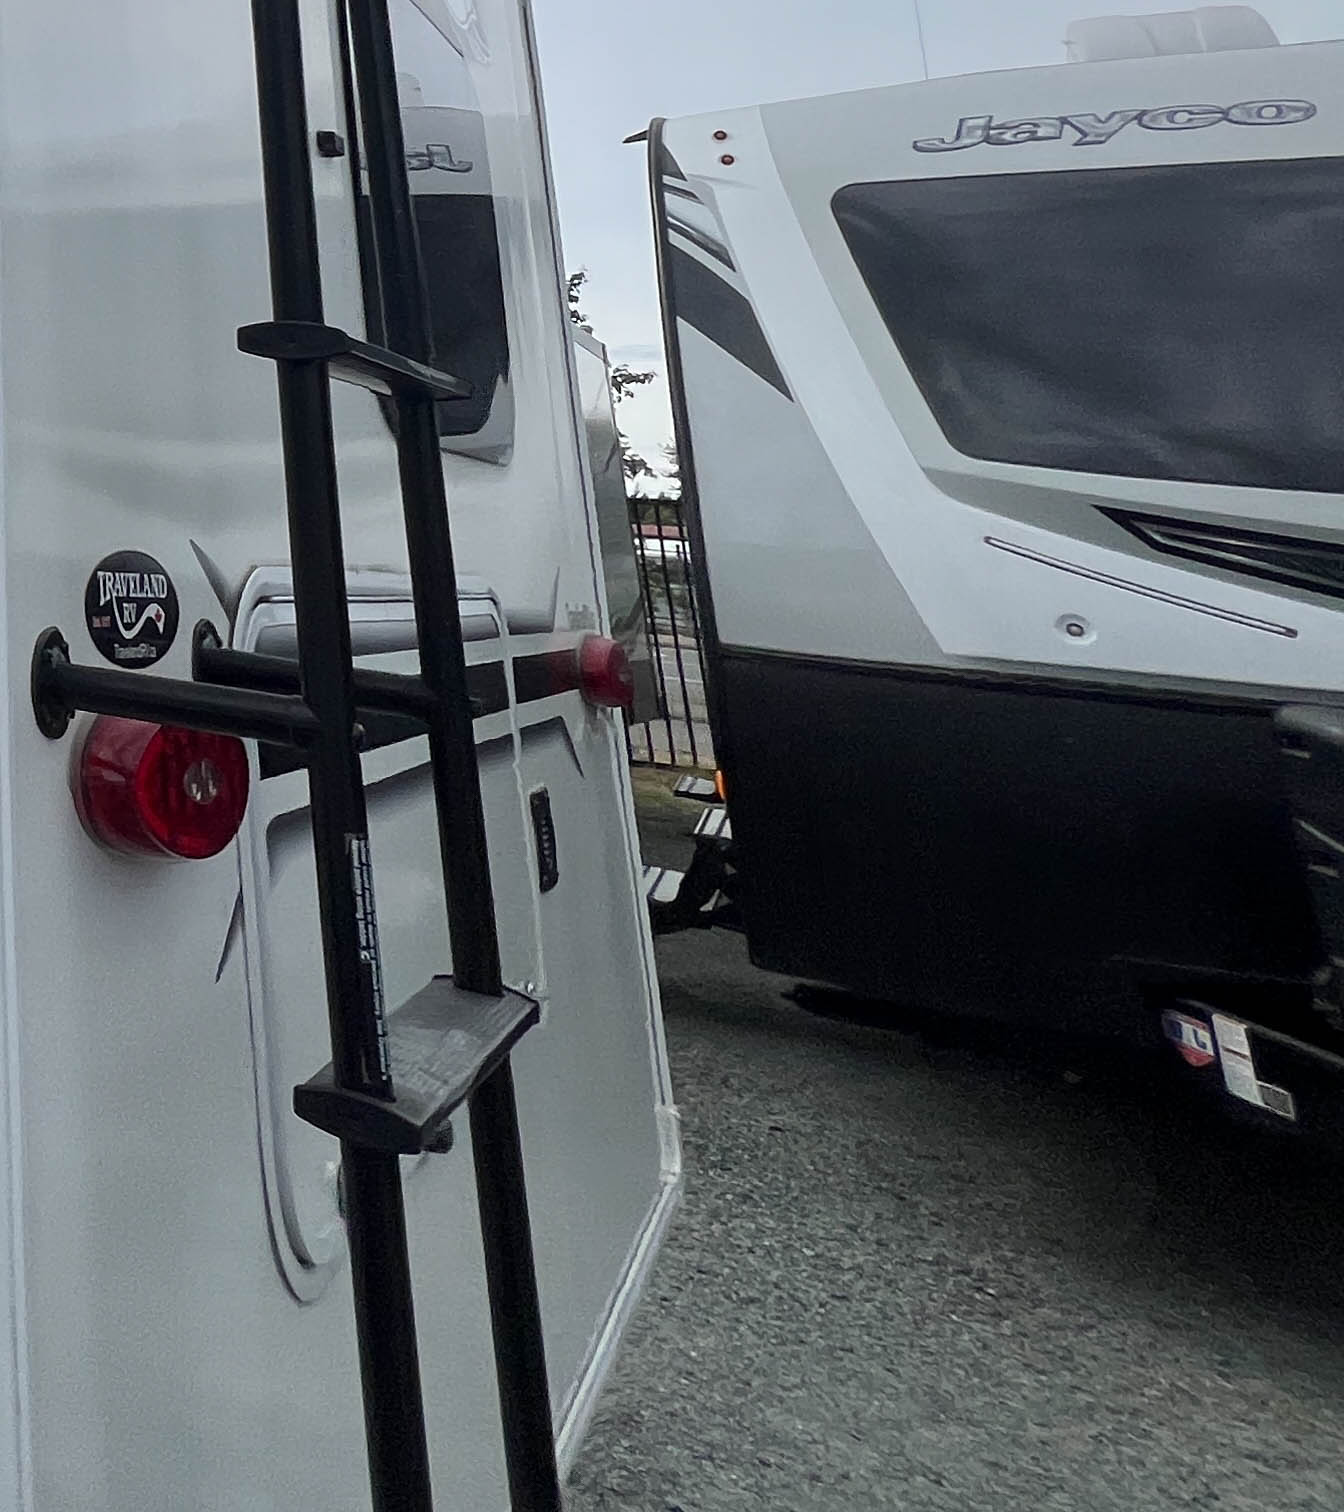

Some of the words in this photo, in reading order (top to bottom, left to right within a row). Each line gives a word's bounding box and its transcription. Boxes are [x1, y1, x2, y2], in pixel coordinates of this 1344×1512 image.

[912, 99, 1318, 153] Jayco
[97, 571, 168, 606] TRAVELAND
[123, 603, 137, 623] RV
